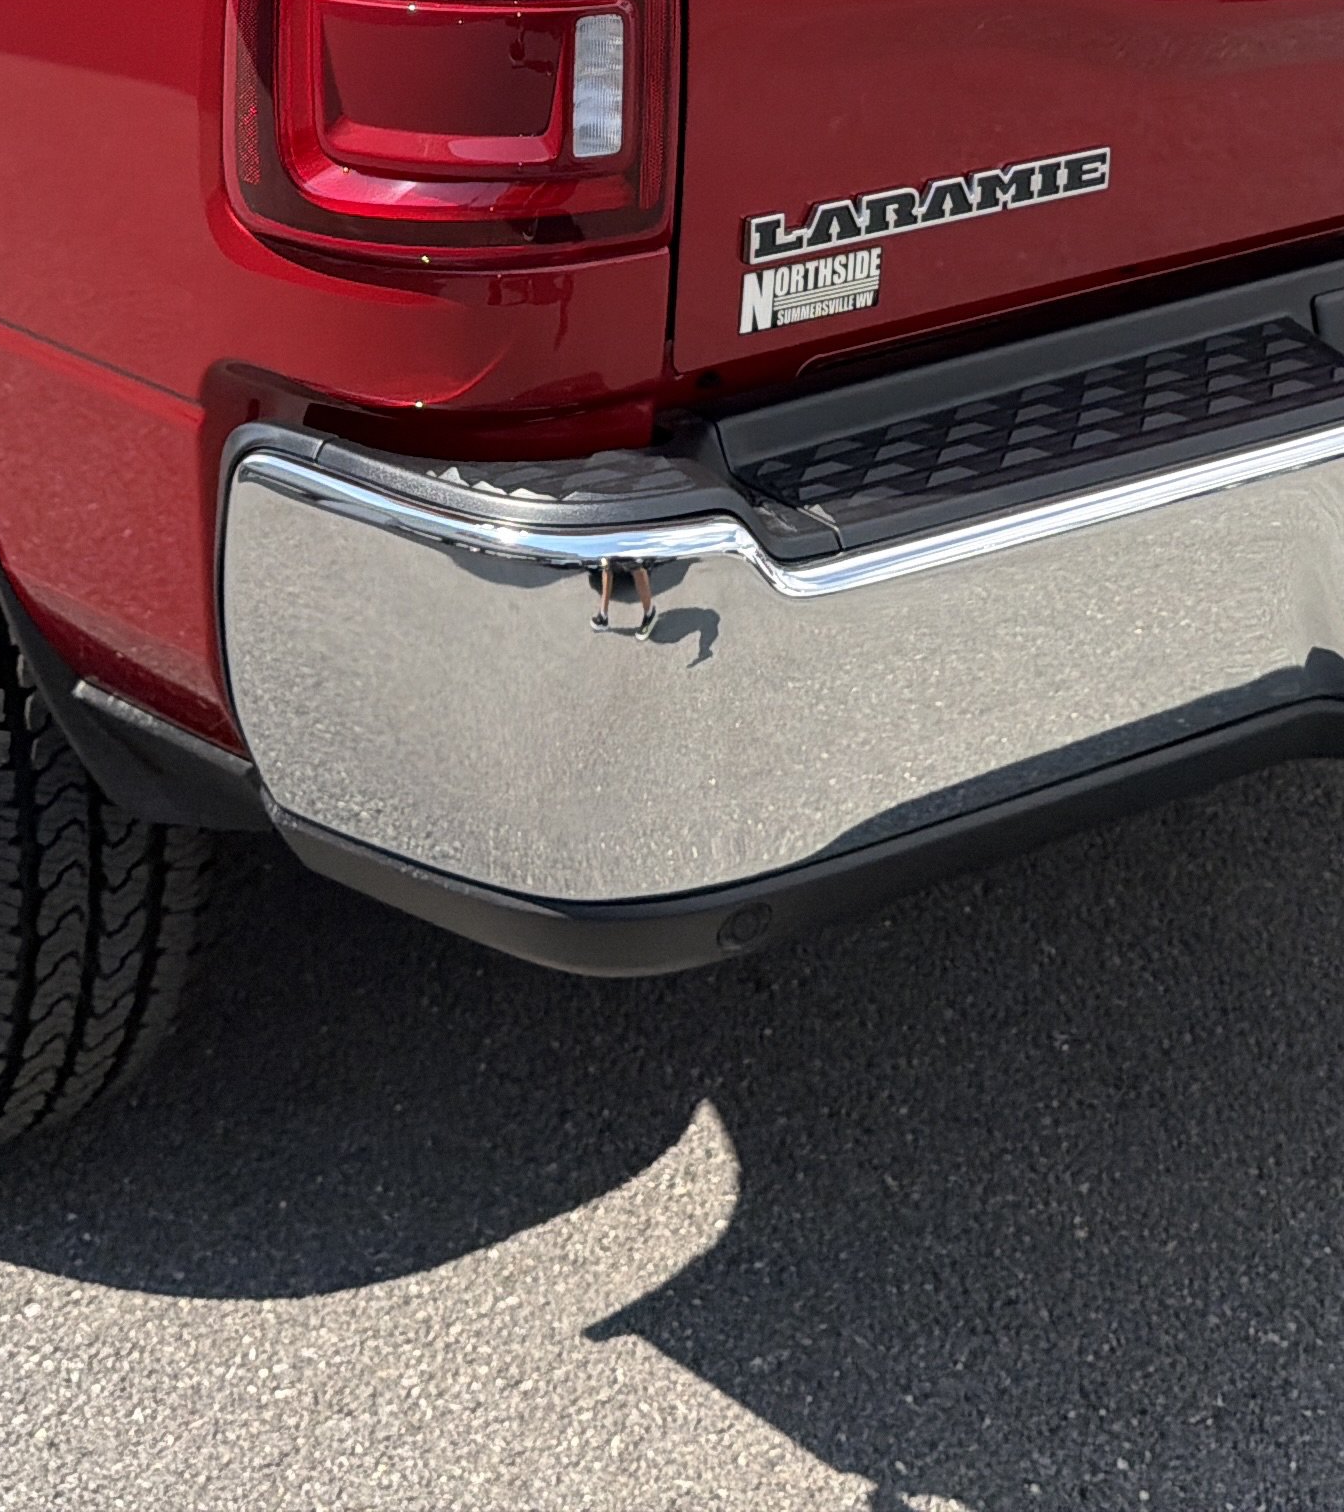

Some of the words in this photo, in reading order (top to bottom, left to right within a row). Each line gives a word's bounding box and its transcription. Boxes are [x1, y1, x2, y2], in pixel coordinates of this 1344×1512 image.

[746, 147, 1110, 263] LARAMIE
[739, 247, 882, 334] NORTHSIDE
[776, 294, 855, 327] SUMMERSVILLE
[856, 290, 875, 309] WV
